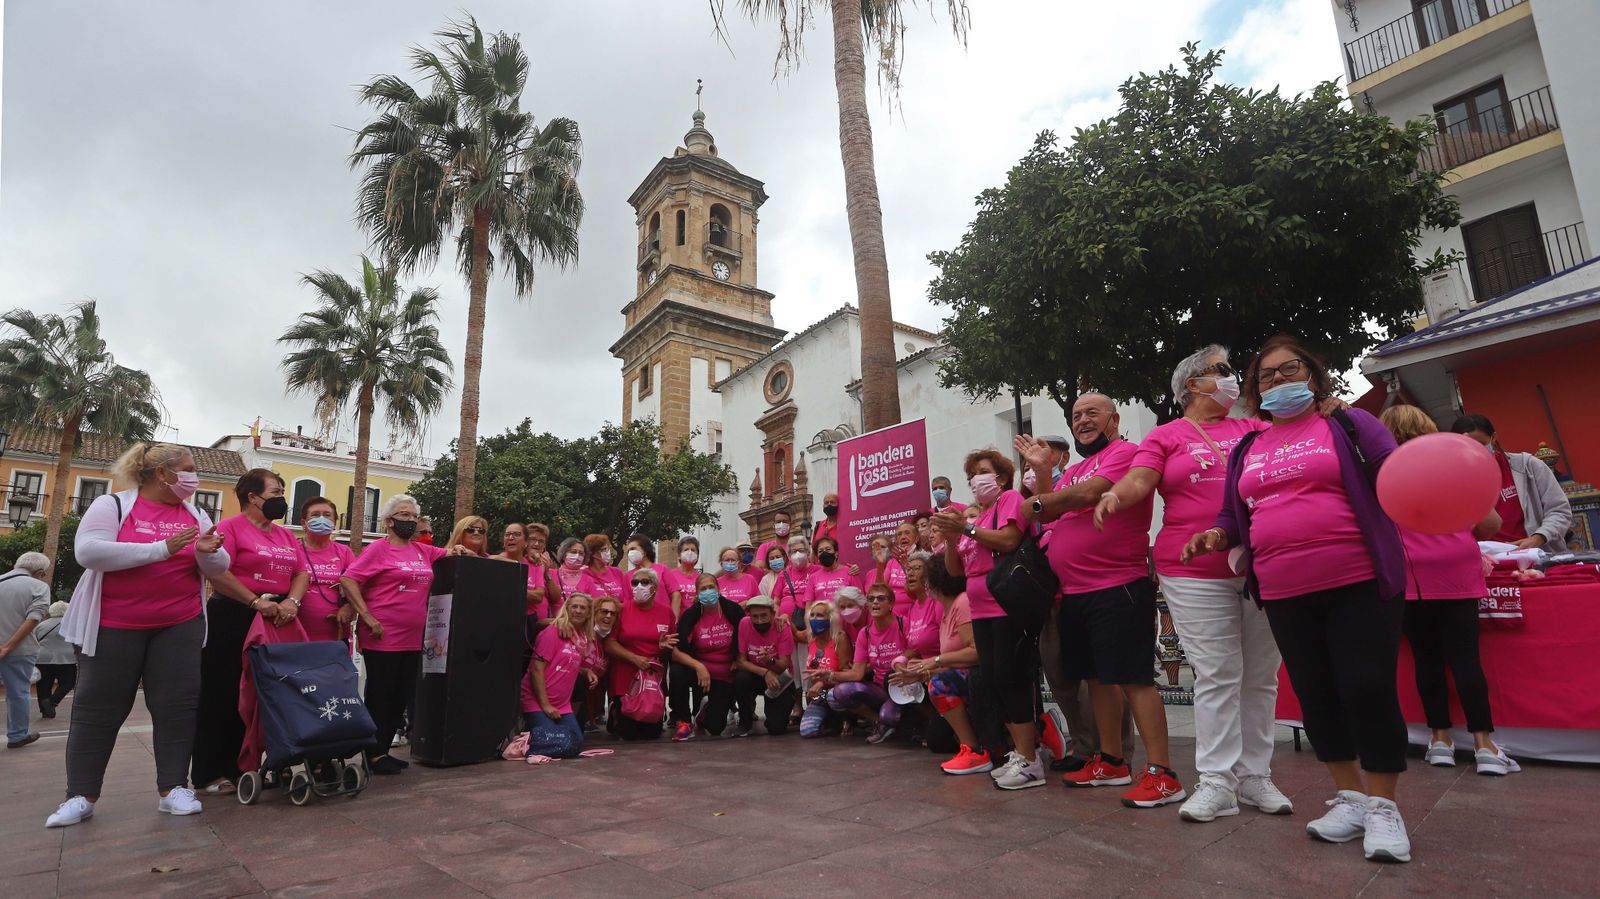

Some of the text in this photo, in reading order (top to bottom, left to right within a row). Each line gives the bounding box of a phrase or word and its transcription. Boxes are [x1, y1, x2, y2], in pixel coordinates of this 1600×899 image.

[1275, 438, 1316, 456] aecc
[858, 443, 914, 470] bandera
[858, 465, 889, 487] rosa
[1270, 462, 1307, 477] aecc
[849, 515, 880, 527] ASOCIACIÓN
[888, 509, 918, 520] PACIENTES
[159, 521, 188, 530] aecc
[865, 521, 898, 532] FAMILIARES
[855, 541, 870, 549] CAM
[1478, 597, 1498, 610] sa
[711, 623, 728, 632] aecc
[878, 642, 897, 650] aecc
